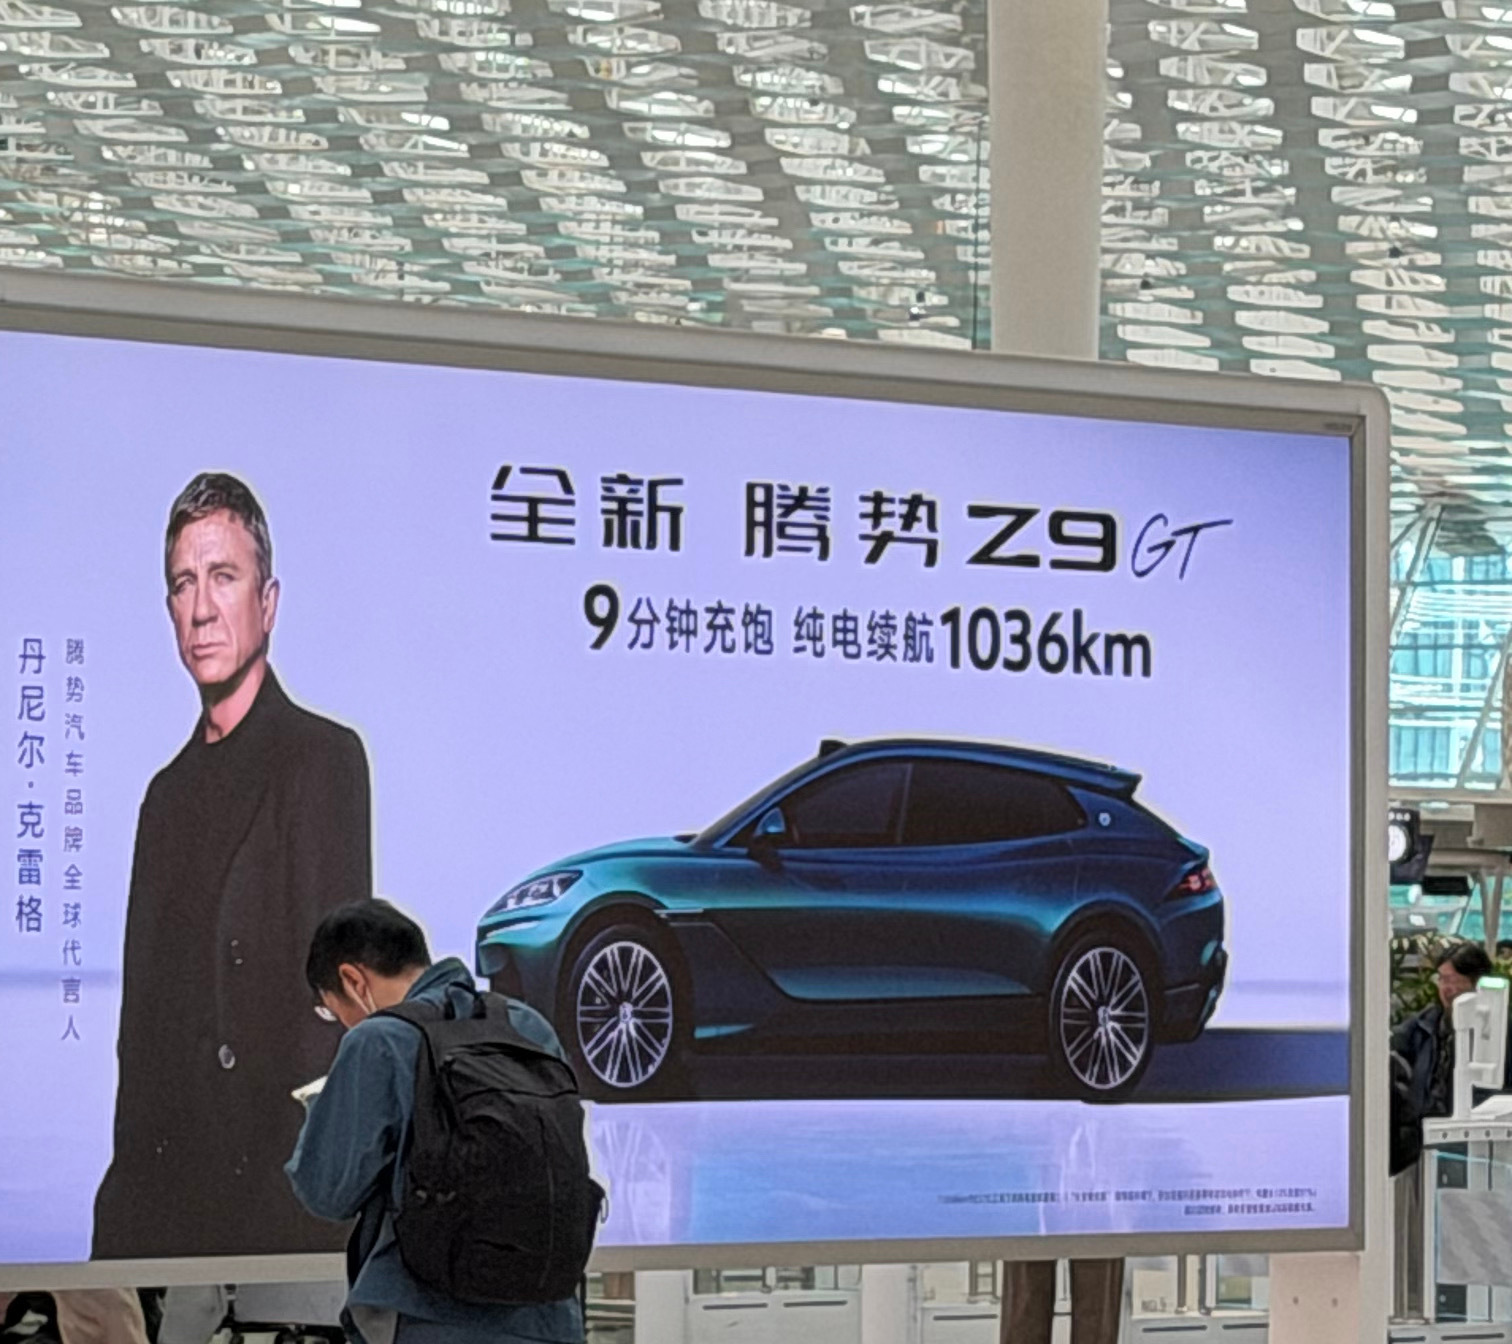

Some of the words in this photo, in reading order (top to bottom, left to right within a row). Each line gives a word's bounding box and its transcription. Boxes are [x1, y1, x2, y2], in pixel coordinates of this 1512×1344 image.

[490, 464, 684, 552] 全新
[1131, 513, 1234, 581] GT
[583, 583, 774, 655] 9分钟充饱
[60, 637, 86, 1042] 腾势汽车品牌全球代言人
